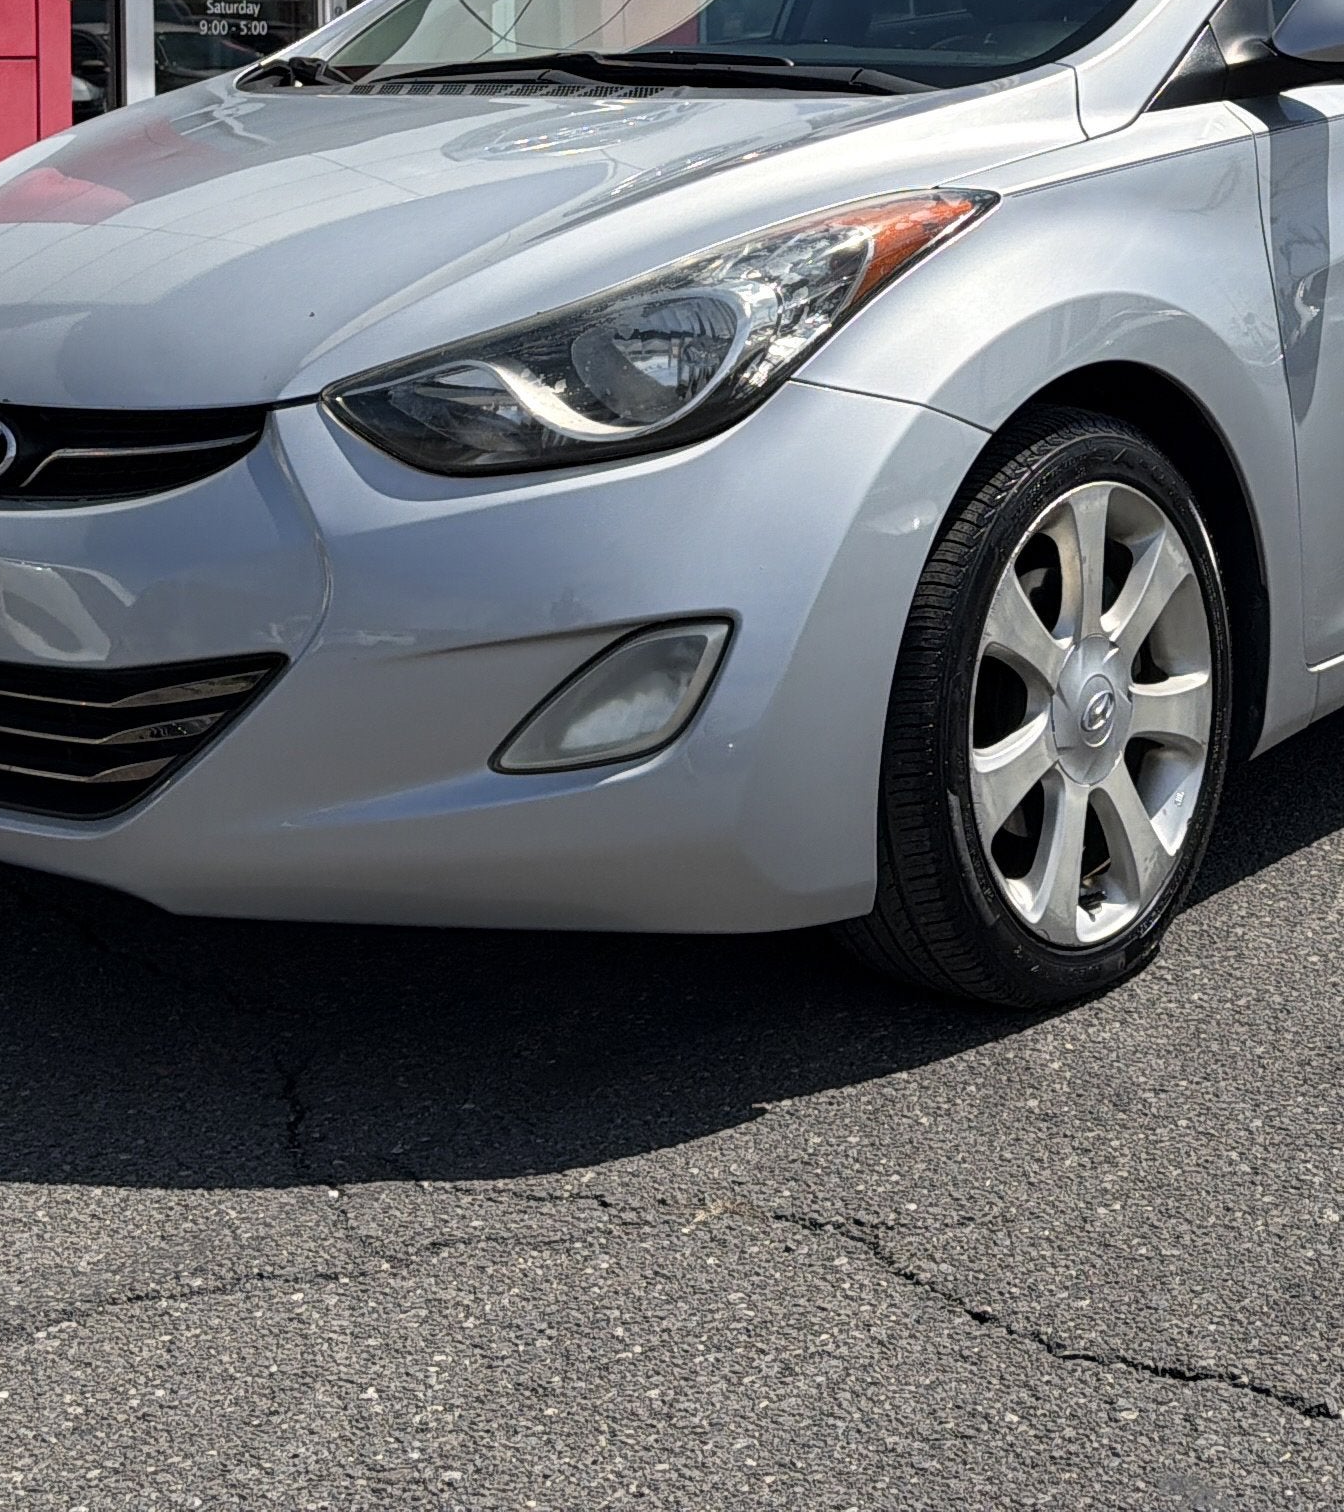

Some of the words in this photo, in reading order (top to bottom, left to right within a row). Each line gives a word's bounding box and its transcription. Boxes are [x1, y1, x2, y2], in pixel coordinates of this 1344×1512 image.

[206, 0, 261, 18] Saturday
[199, 20, 229, 36] 9:00
[239, 21, 268, 36] 5:00
